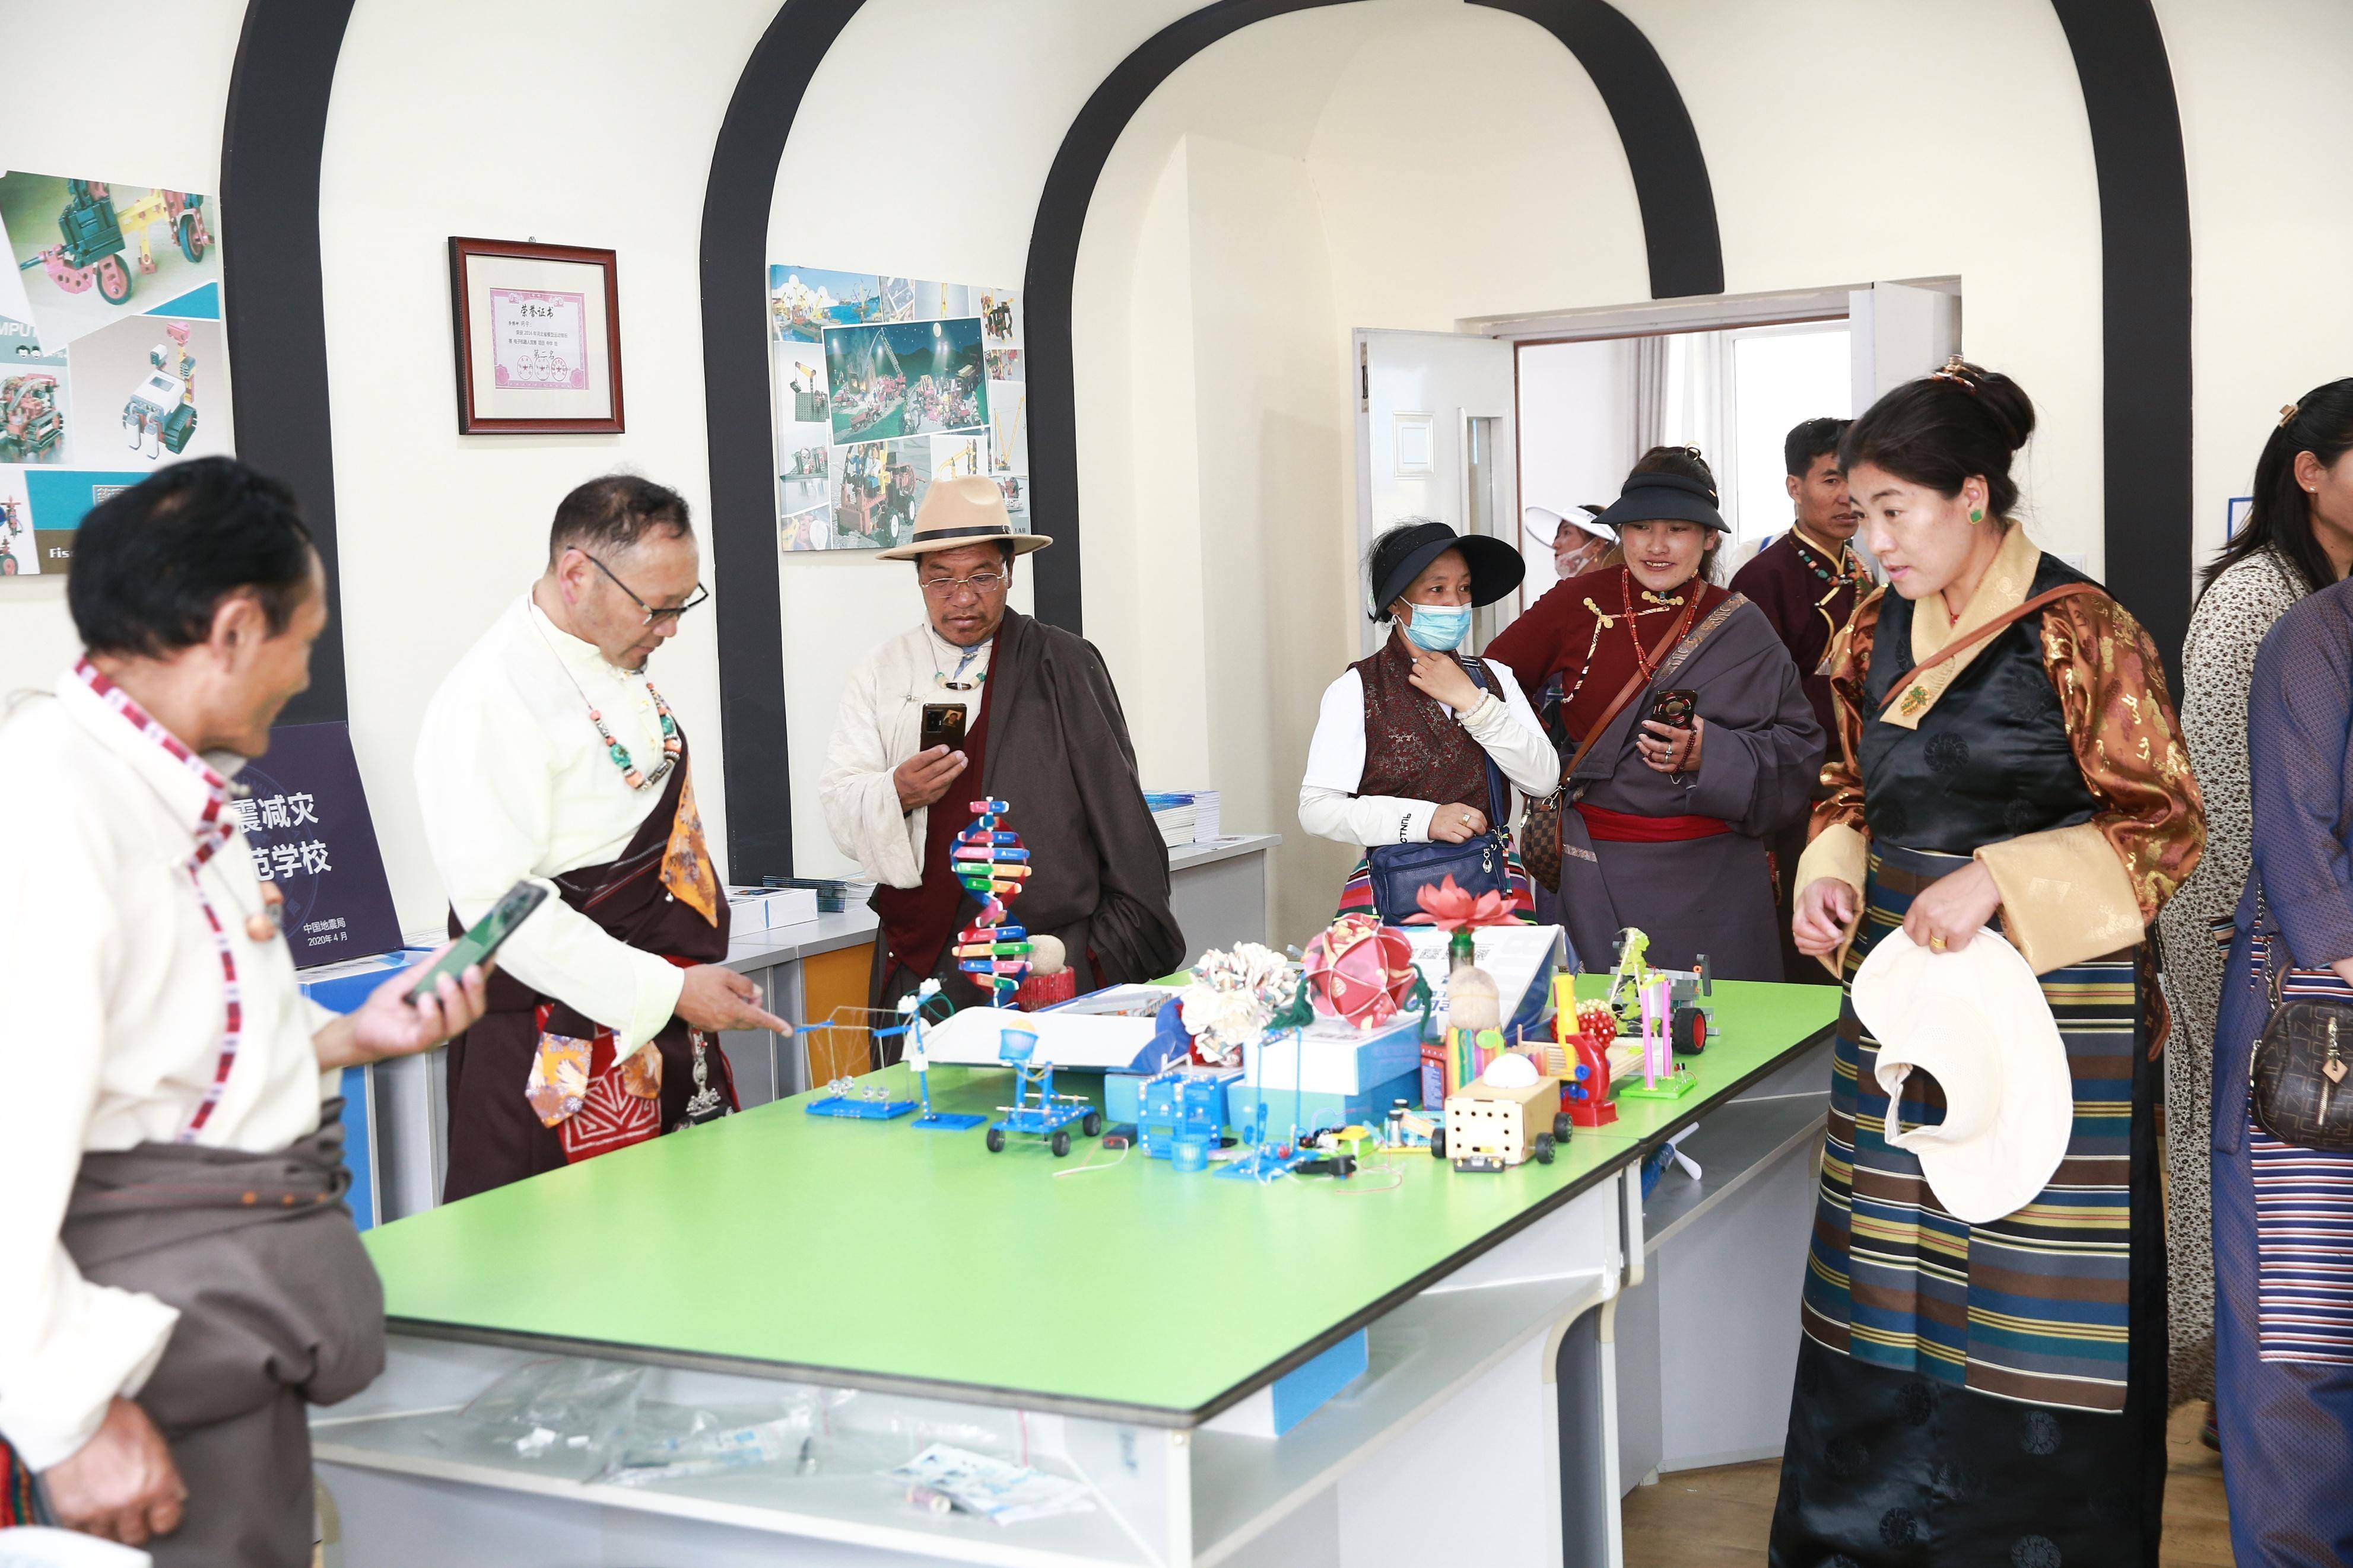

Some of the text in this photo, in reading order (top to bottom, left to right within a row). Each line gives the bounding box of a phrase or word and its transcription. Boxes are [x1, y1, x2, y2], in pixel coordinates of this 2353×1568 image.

[521, 304, 554, 319] 荣誉证书
[303, 917, 345, 934] 中国地震局
